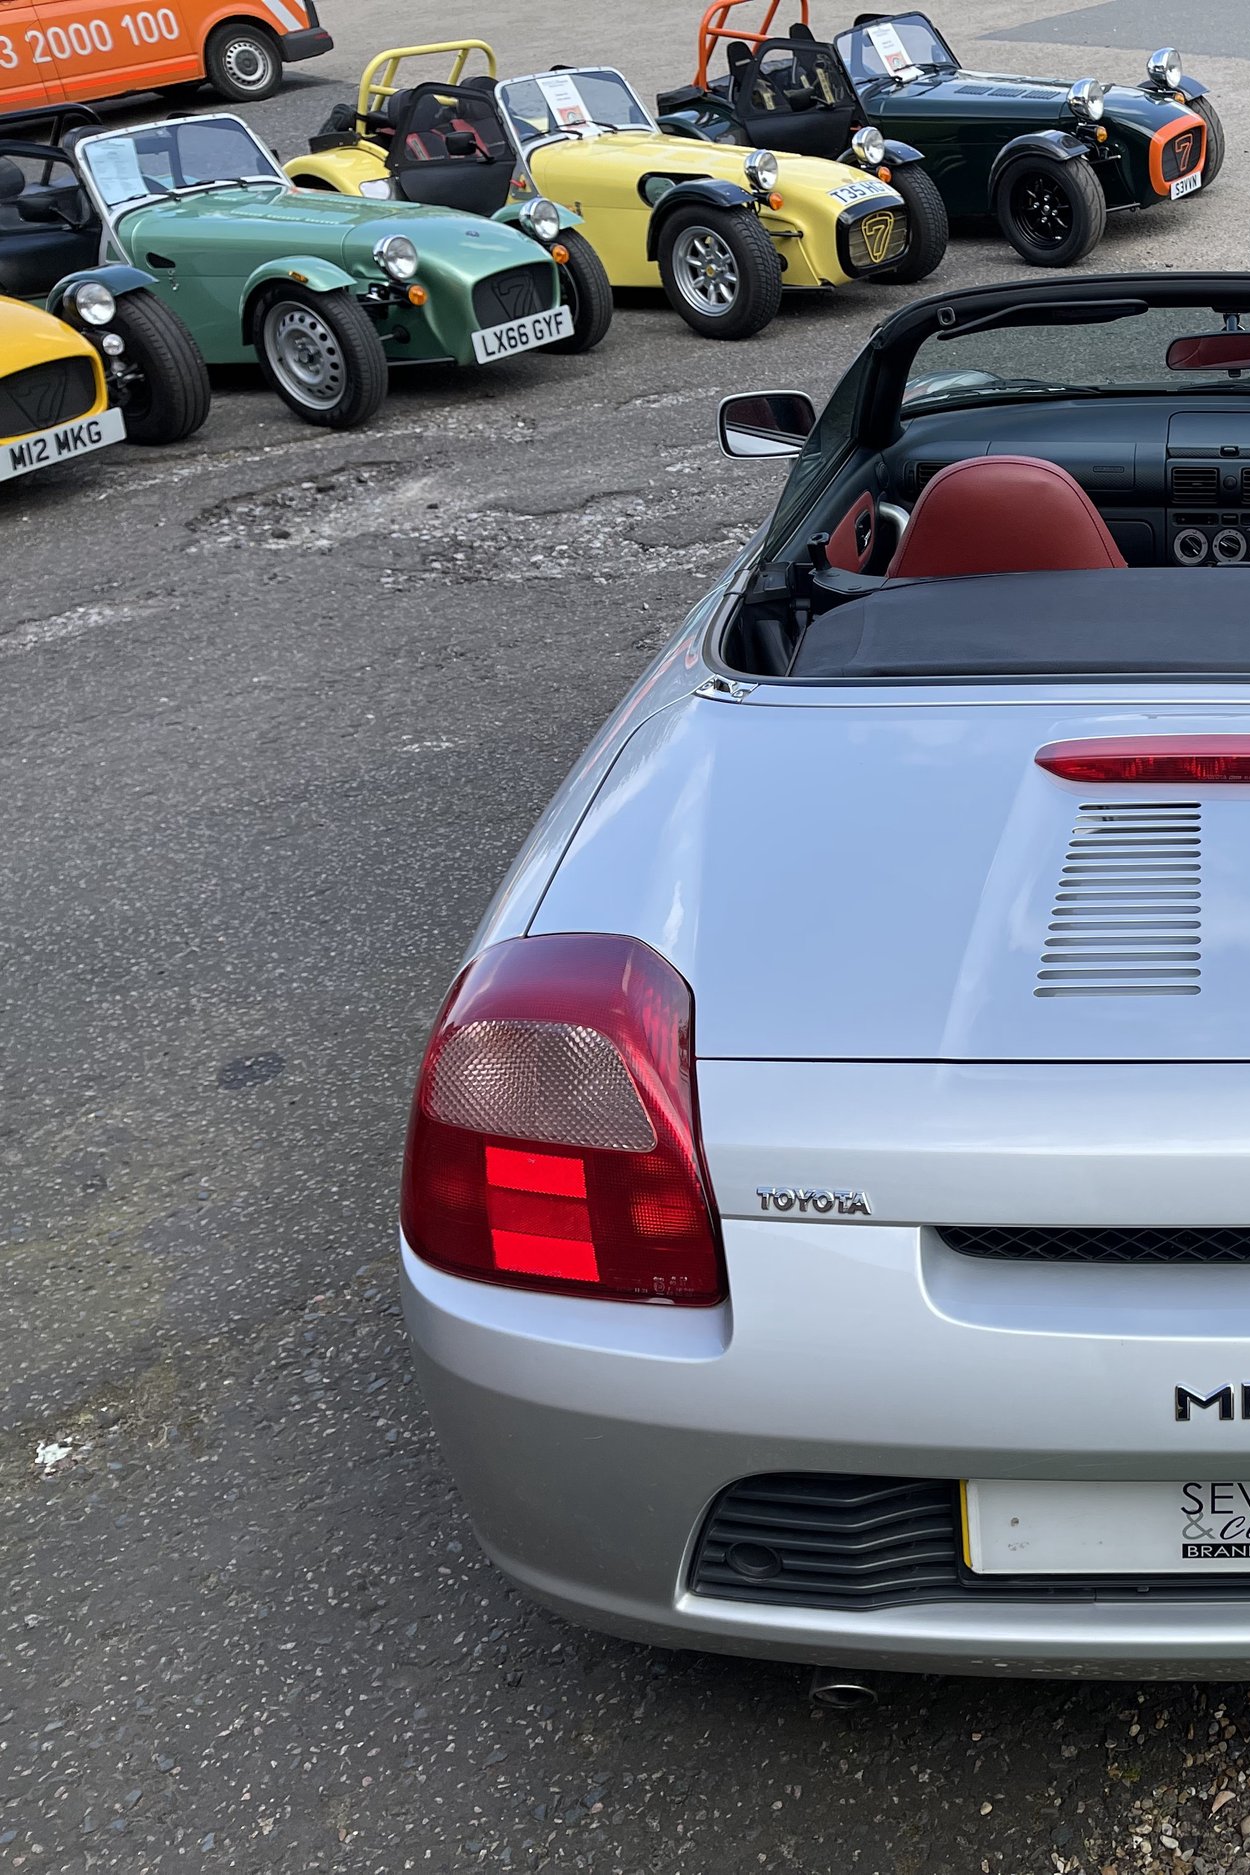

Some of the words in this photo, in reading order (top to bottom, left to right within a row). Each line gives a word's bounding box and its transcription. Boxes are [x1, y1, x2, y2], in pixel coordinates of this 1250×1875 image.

[25, 19, 113, 64] 2000
[121, 8, 179, 46] 100
[1175, 133, 1193, 172] 7
[830, 185, 866, 203] T35
[866, 216, 890, 256] 7
[482, 324, 529, 357] LX66
[532, 312, 563, 340] GYF
[9, 438, 49, 471] M12
[54, 421, 102, 456] MKG
[756, 1187, 872, 1215] TOYOTA
[1182, 1511, 1216, 1540] &
